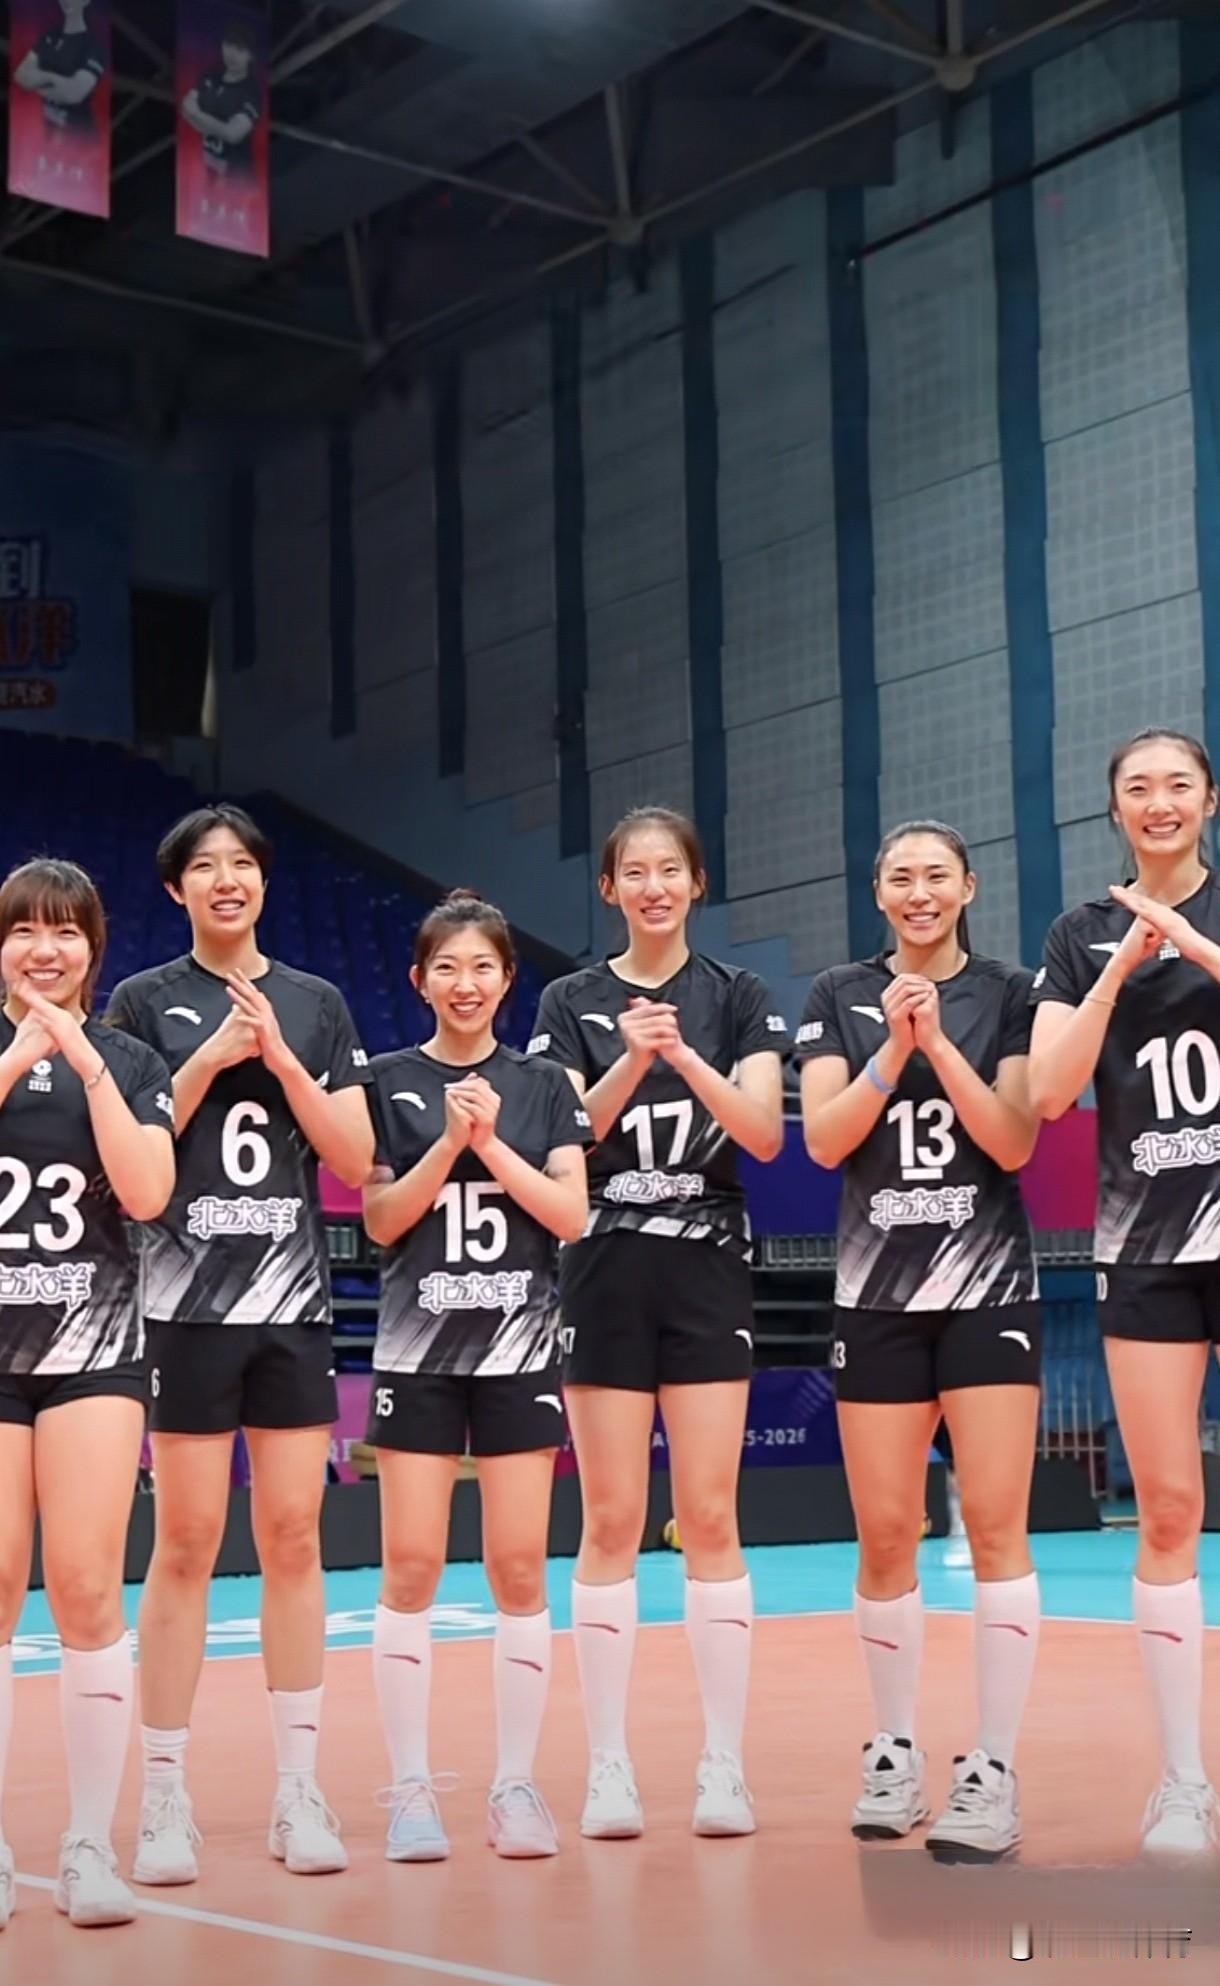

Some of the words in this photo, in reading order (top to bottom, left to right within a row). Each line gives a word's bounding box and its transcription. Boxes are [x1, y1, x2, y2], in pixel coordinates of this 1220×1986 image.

[1136, 1030, 1220, 1119] 10
[222, 1101, 271, 1187] 6
[621, 1100, 695, 1171] 17
[887, 1098, 956, 1168] 13
[1131, 1124, 1220, 1177] 北冰
[0, 1156, 86, 1252] 23
[187, 1196, 301, 1243] 北冰洋
[433, 1181, 508, 1264] 15
[870, 1186, 975, 1230] 北冰洋
[418, 1270, 532, 1314] 北冰洋
[151, 1368, 161, 1398] 6
[375, 1388, 394, 1417] 15
[745, 1427, 807, 1446] 5-2026
